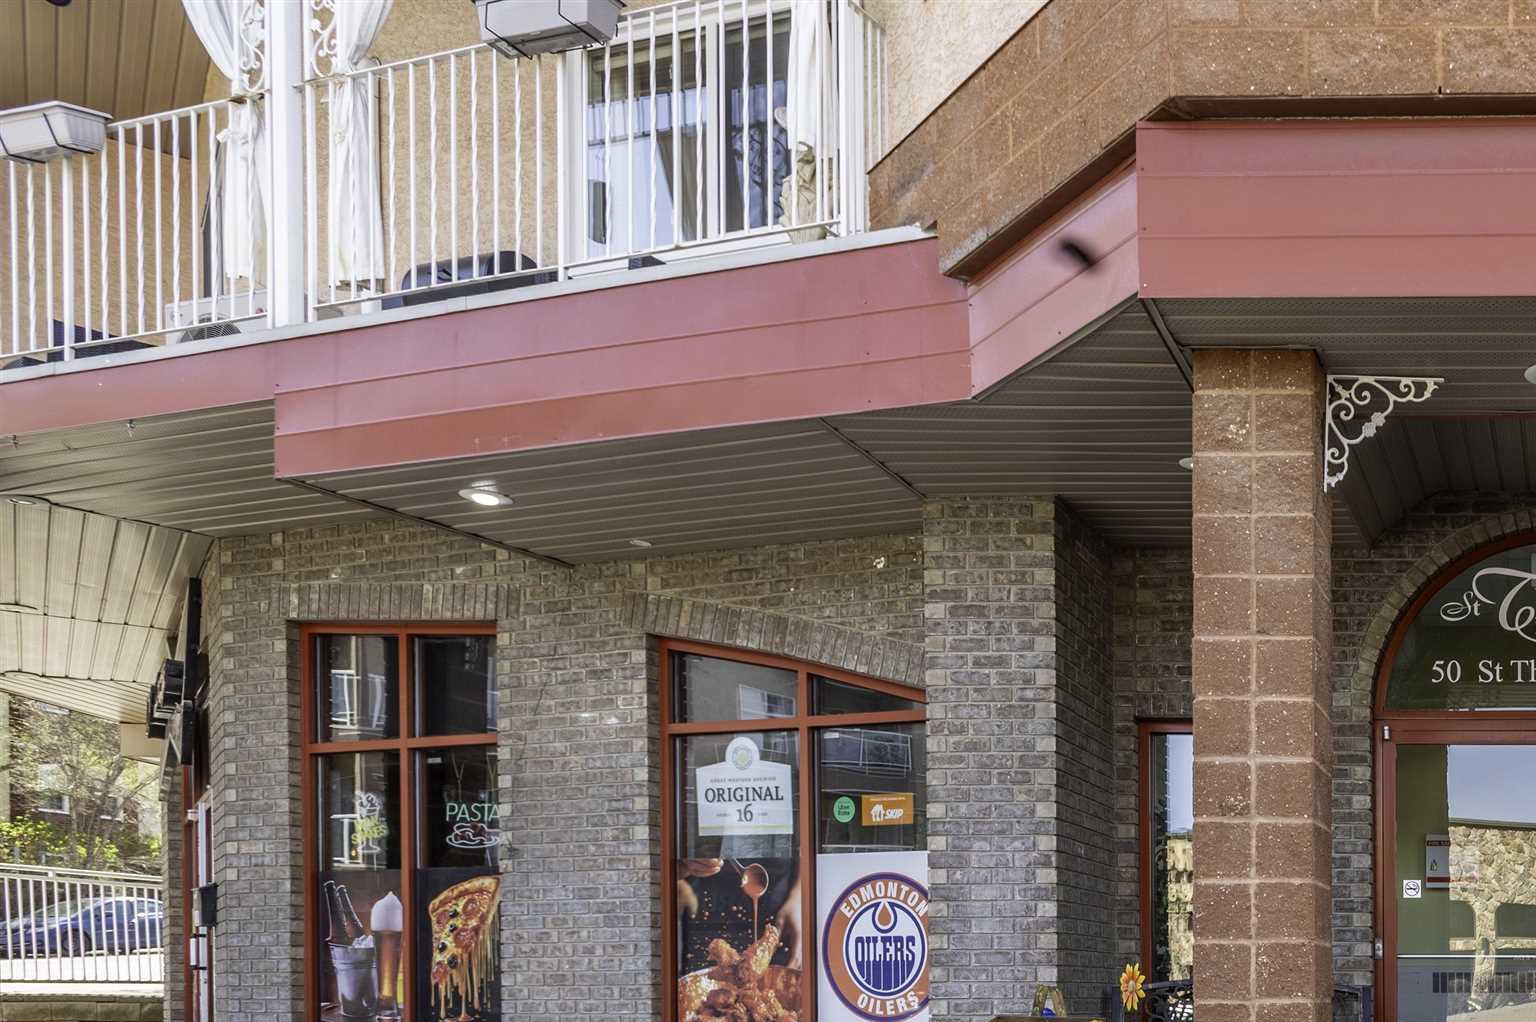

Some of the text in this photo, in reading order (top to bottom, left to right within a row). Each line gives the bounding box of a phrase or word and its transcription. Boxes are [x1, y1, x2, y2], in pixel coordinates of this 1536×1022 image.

[1431, 659, 1462, 684] 50
[1478, 659, 1503, 684] St
[704, 786, 784, 803] ORIGINAL
[736, 803, 754, 822] 16
[854, 935, 916, 991] OILERS
[857, 990, 919, 1016] OILERS
